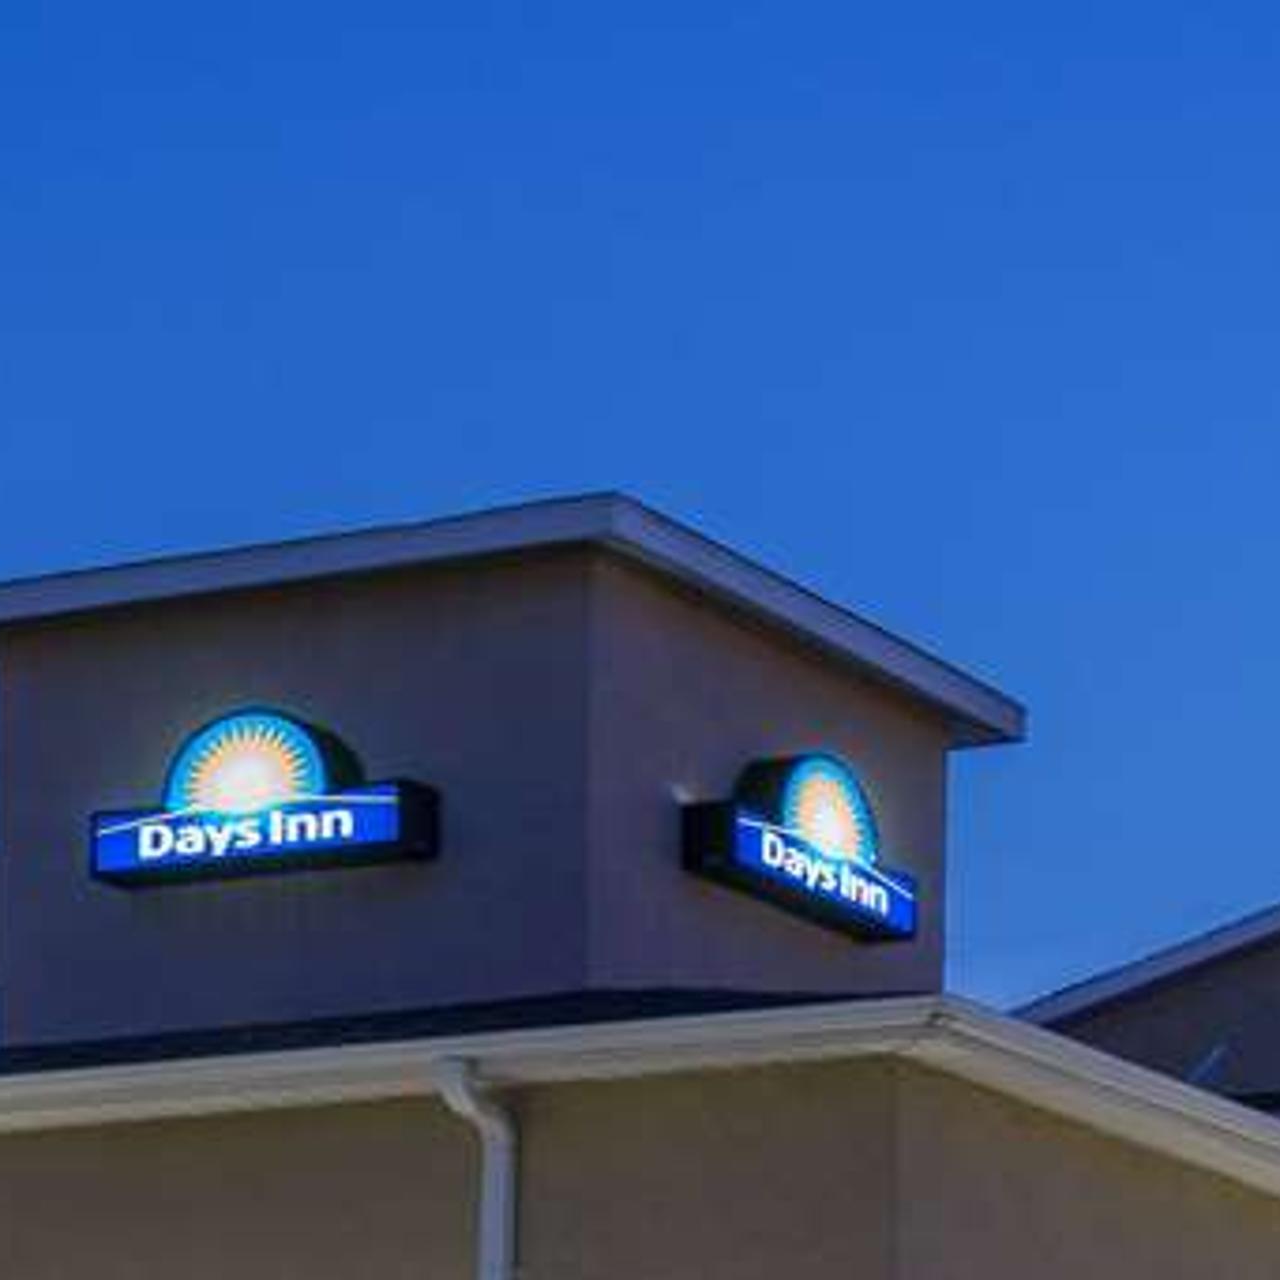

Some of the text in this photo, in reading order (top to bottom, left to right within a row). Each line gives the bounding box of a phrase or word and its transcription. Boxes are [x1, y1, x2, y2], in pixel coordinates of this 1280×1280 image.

[139, 809, 353, 859] Days Inn
[761, 829, 888, 915] Days Inn
